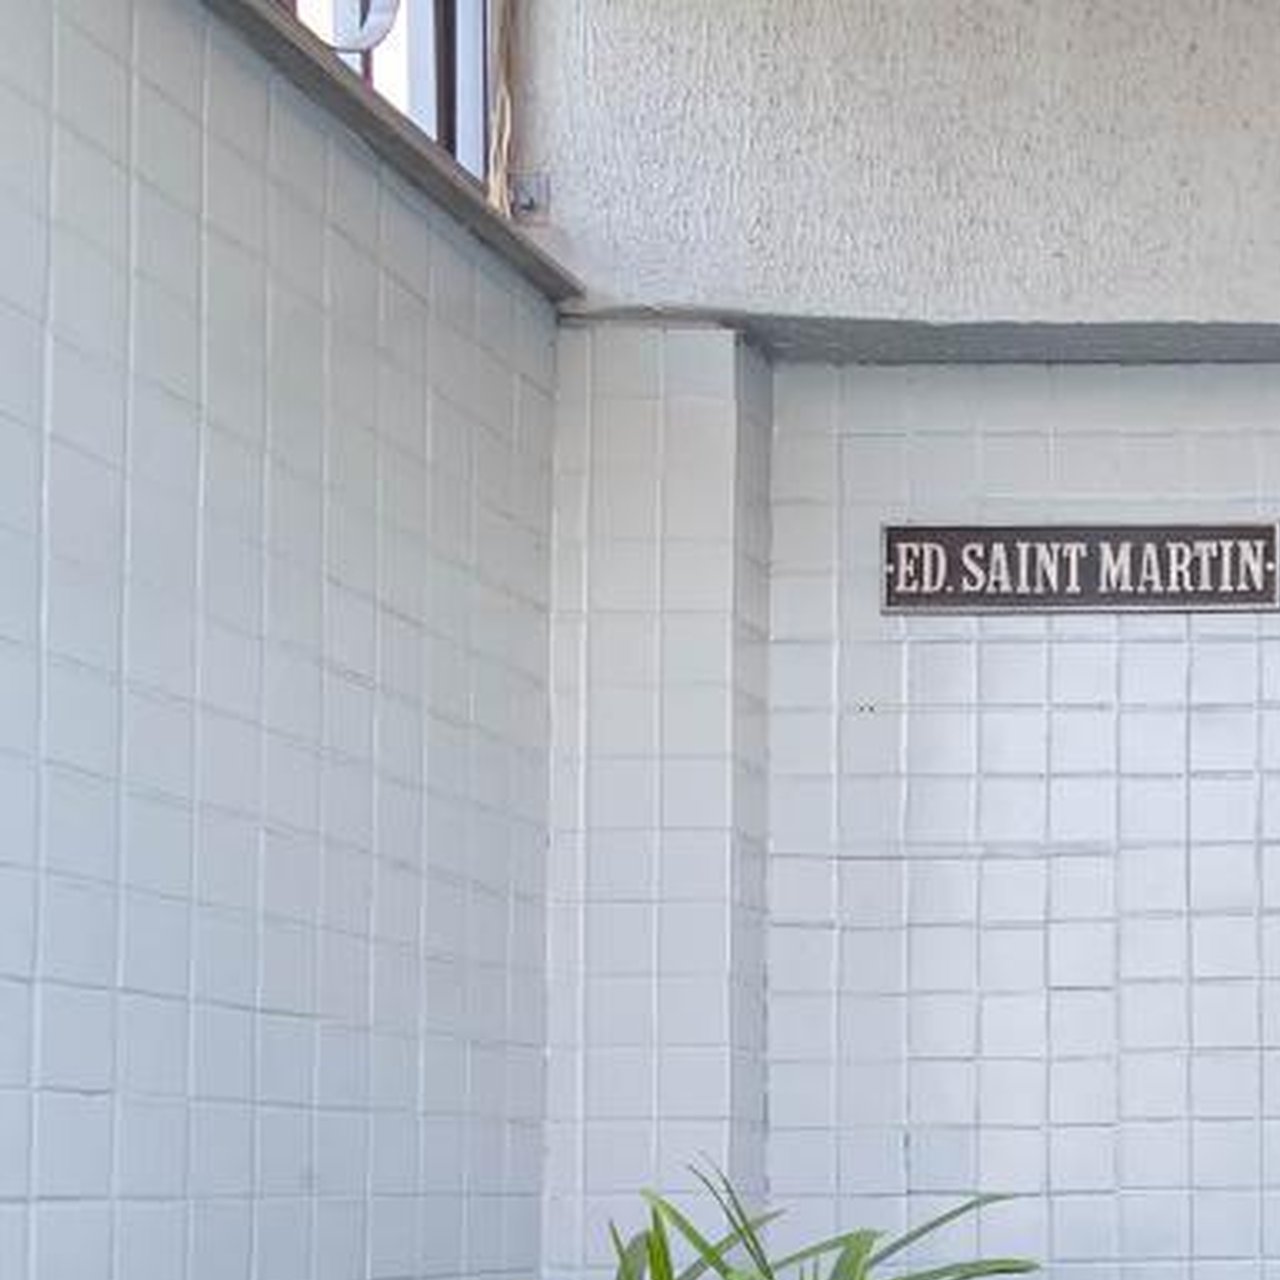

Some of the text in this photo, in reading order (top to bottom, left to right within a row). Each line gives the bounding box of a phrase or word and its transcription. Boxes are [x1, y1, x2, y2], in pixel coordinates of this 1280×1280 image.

[895, 540, 1266, 594] ED. SAINT MARTIN
